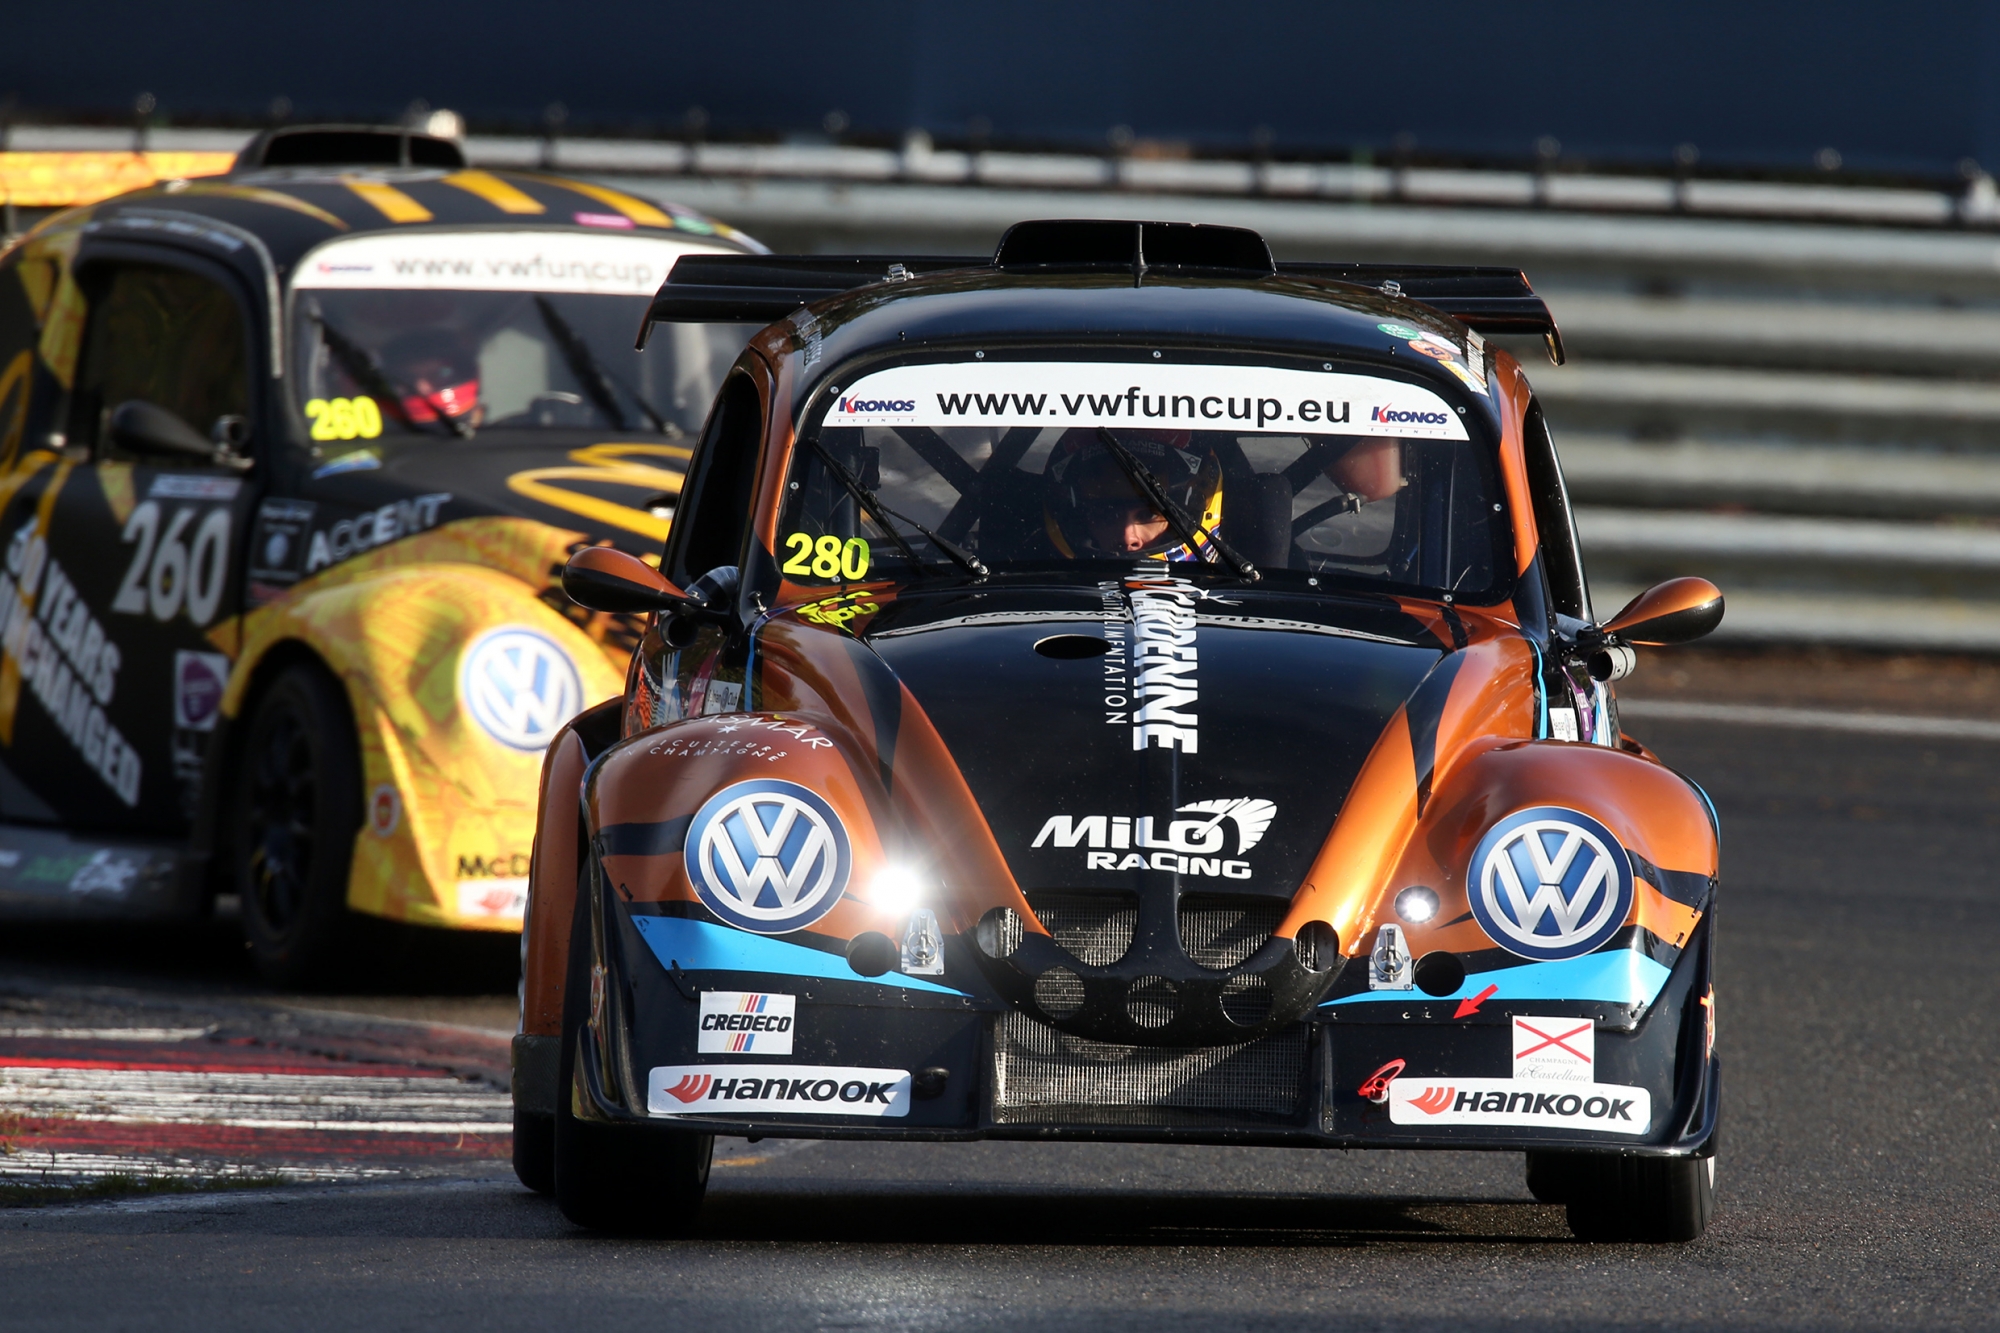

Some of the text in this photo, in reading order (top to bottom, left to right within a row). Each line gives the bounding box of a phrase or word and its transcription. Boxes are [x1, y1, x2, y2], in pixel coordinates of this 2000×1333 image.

[304, 395, 383, 441] 260
[838, 393, 916, 413] KRONOS
[936, 386, 1351, 428] www.vwfuncup.eu
[1371, 402, 1448, 424] KRONOS
[305, 492, 453, 573] ACCENT
[111, 499, 232, 626] 260
[782, 532, 870, 580] 280
[39, 559, 121, 706] YEARS
[649, 746, 780, 763] CHAMPAGNE
[1087, 852, 1252, 880] RACING
[701, 1013, 792, 1033] CREDECO
[1529, 1057, 1579, 1065] CHAMPAGNE
